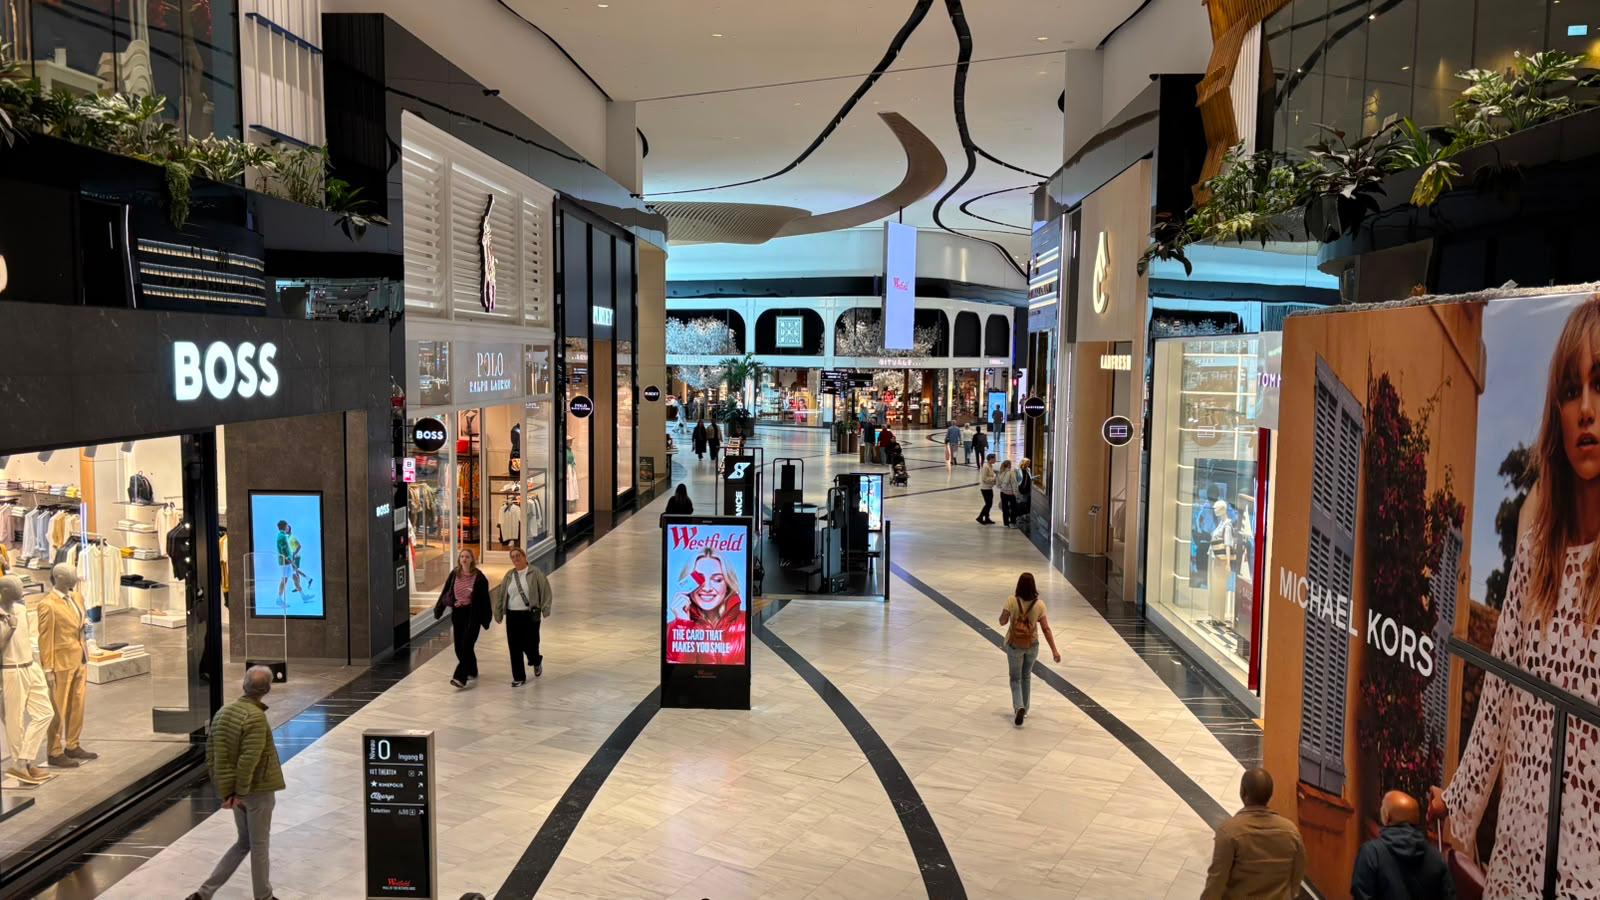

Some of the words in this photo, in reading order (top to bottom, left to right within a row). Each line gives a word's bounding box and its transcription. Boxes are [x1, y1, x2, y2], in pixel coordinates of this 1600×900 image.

[174, 341, 279, 401] BOSS
[476, 352, 504, 377] POLO
[469, 380, 488, 393] RALPH
[490, 378, 512, 391] LAUREN
[416, 430, 444, 440] BOSS
[376, 503, 390, 517] BOSS
[671, 526, 746, 552] Westfield
[1279, 566, 1358, 637] MICHAEL
[1367, 608, 1434, 677] KORS
[672, 629, 686, 641] THE
[686, 629, 705, 641] CARD
[705, 630, 724, 641] THAT
[672, 641, 695, 653] MAKES
[696, 641, 710, 653] YOU
[710, 642, 730, 654] SMILE
[398, 753, 418, 762] Ingang
